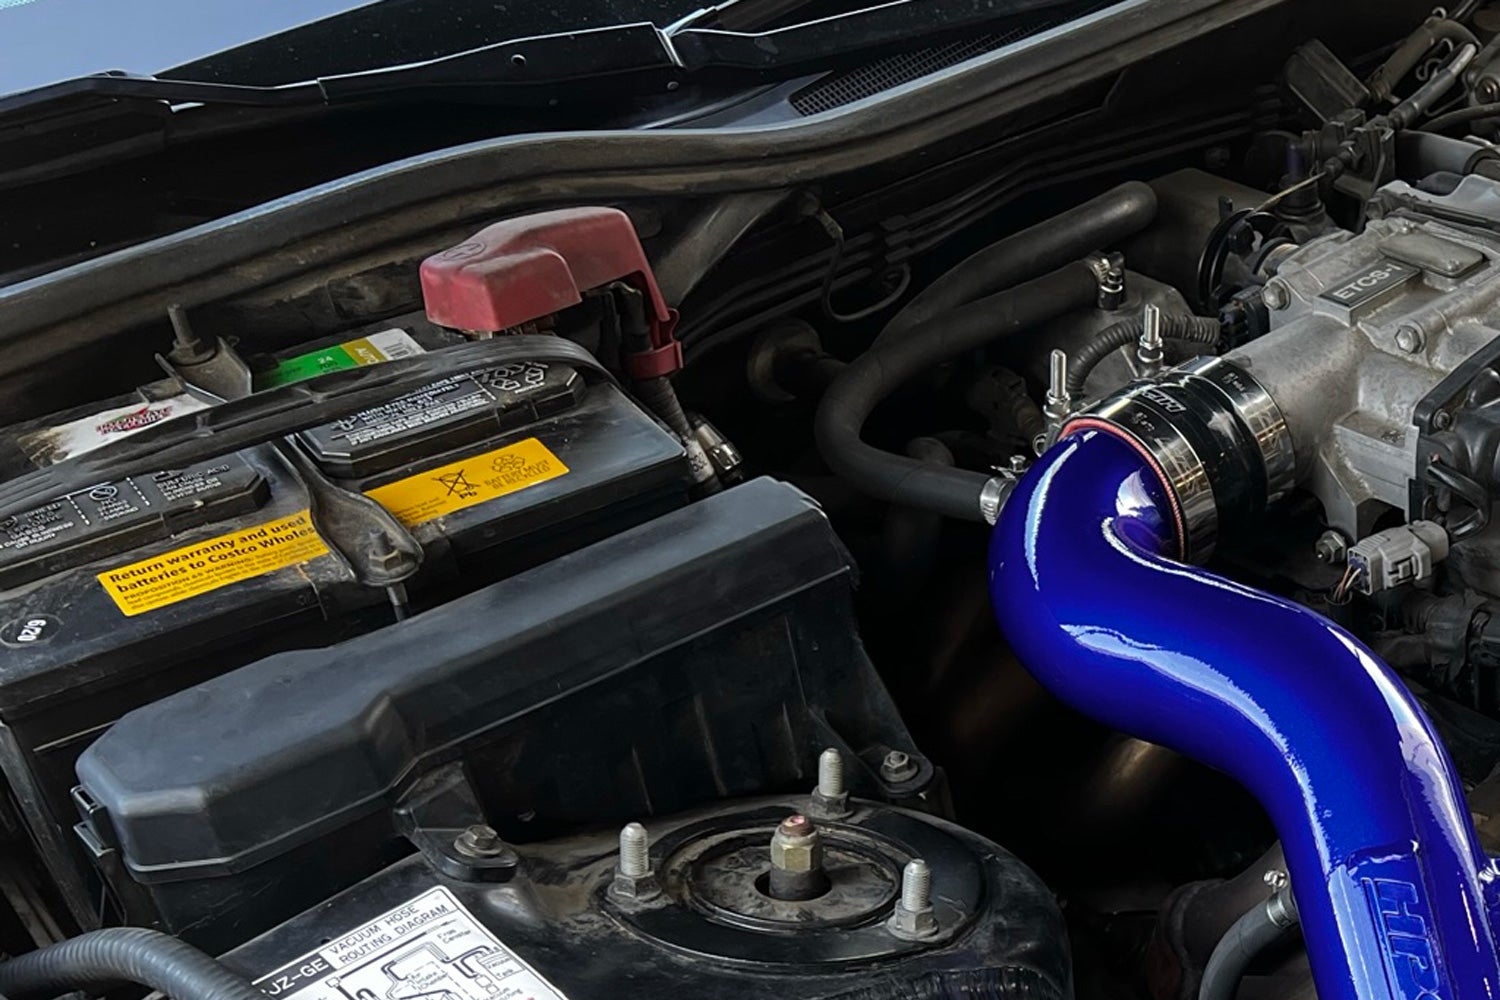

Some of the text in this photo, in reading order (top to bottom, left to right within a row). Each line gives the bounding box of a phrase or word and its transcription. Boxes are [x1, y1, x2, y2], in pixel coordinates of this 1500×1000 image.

[459, 490, 477, 500] Pb
[109, 562, 166, 583] Return
[166, 539, 236, 566] warranty
[238, 527, 268, 544] and
[270, 516, 307, 539] used
[117, 565, 188, 593] batteries
[190, 558, 206, 571] to
[208, 544, 258, 564] Costco
[17, 619, 47, 641] 6/20
[330, 904, 420, 954] VACUUM HOSE
[339, 904, 450, 964] ROUTING DIAGRAM
[261, 957, 330, 995] JZ-GE
